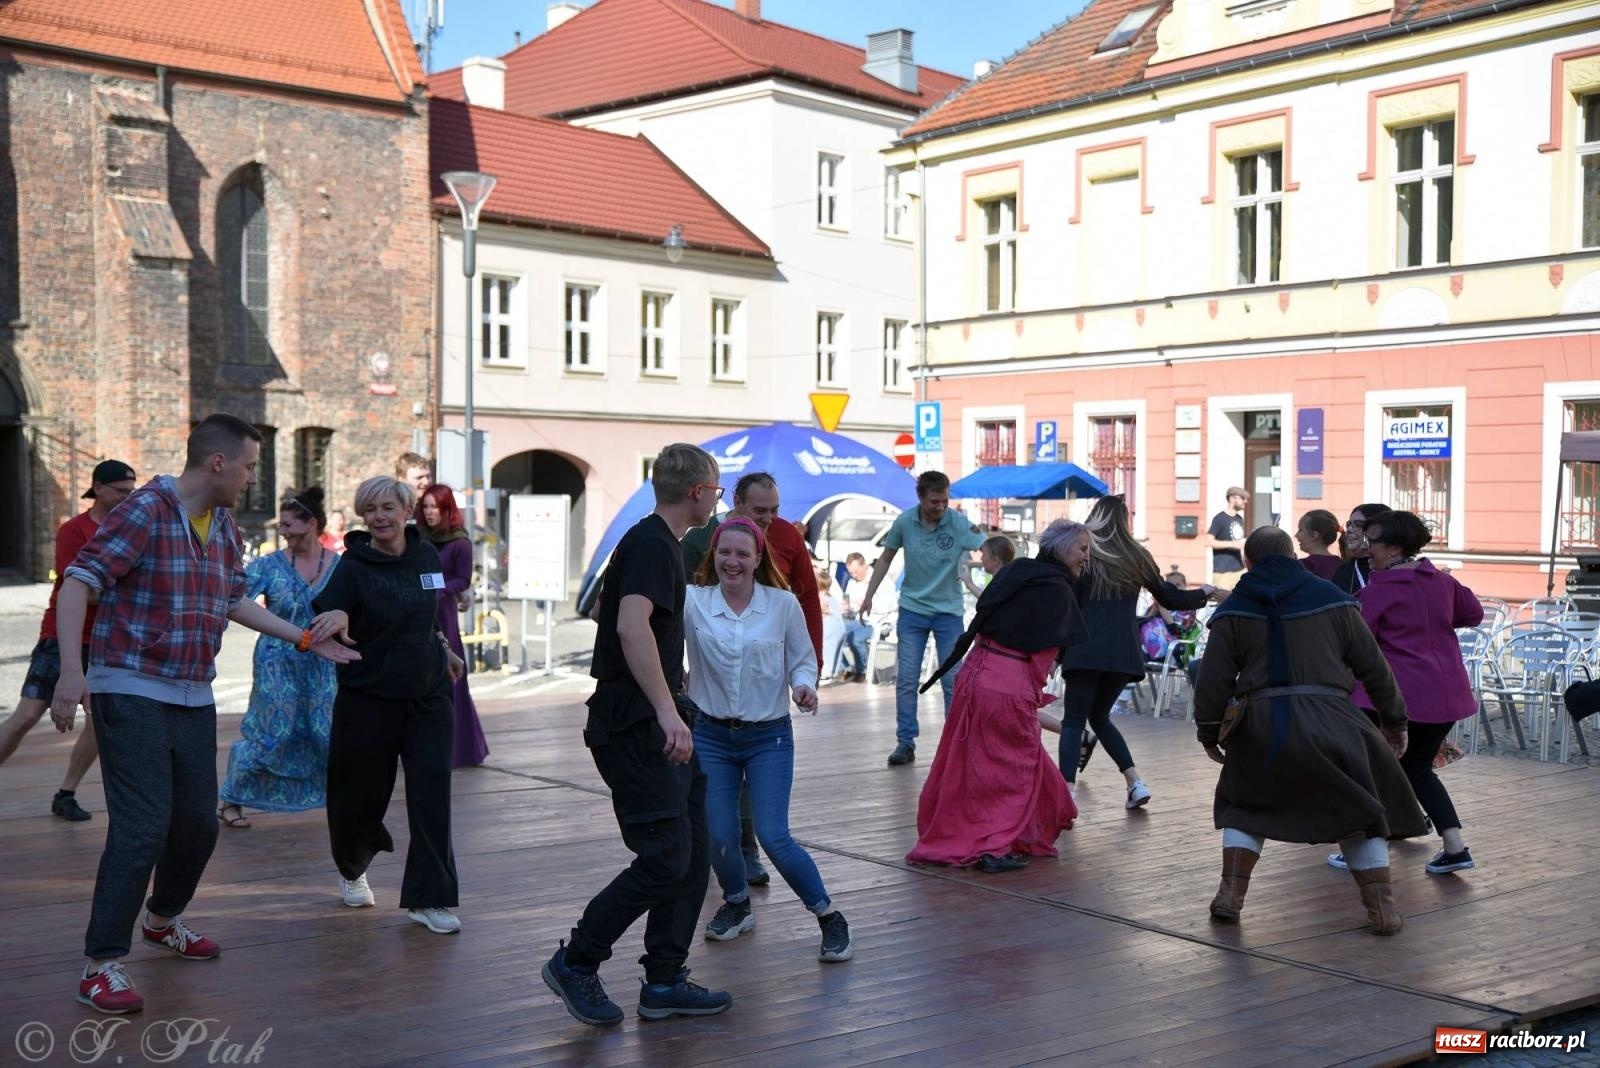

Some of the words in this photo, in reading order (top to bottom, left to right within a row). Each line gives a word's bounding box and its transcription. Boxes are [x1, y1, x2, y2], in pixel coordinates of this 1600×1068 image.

[919, 405, 937, 438] P
[1390, 421, 1444, 435] AGIMEX
[1040, 423, 1054, 442] P
